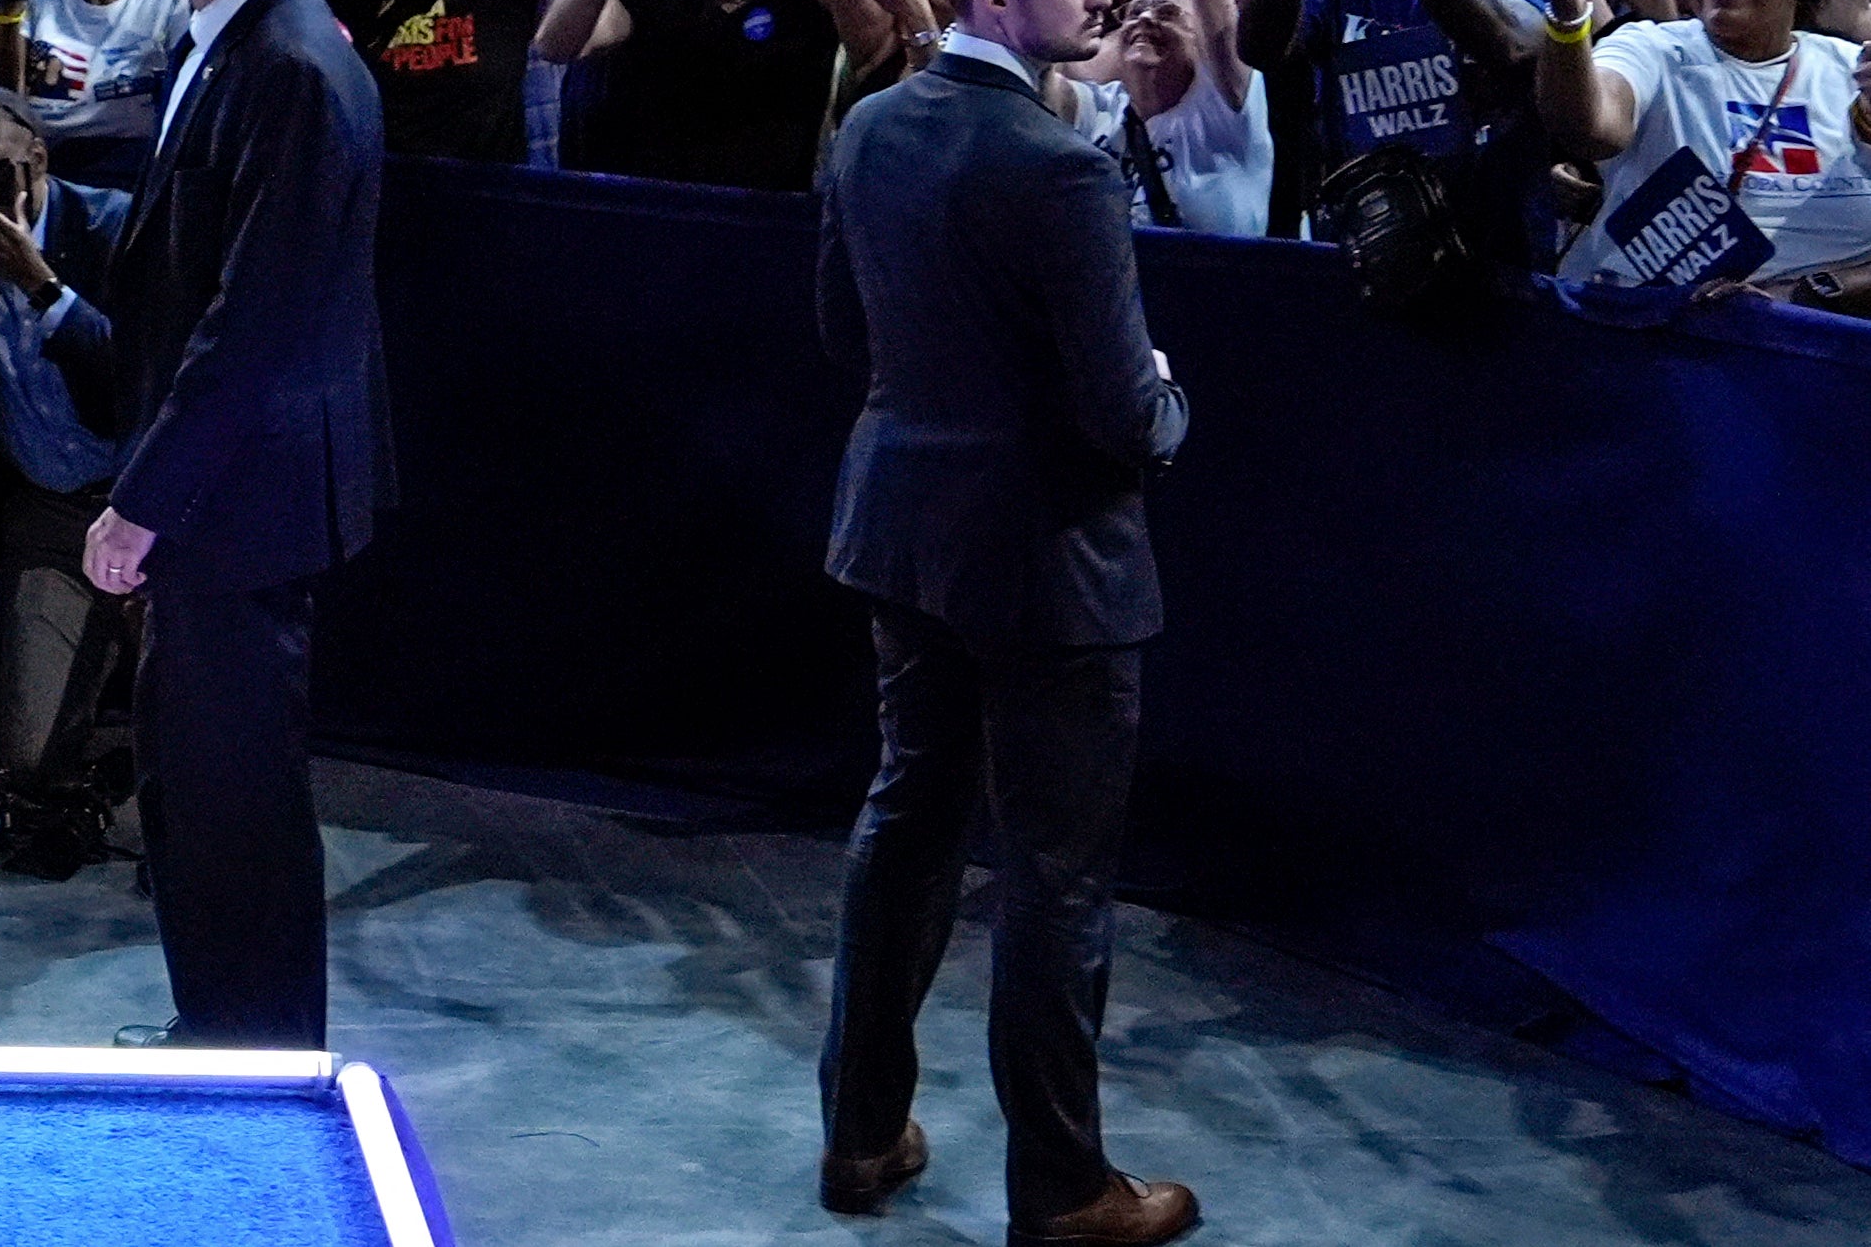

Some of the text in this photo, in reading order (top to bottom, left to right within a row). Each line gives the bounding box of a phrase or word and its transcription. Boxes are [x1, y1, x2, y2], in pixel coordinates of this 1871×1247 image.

[1338, 54, 1458, 115] HARRIS
[1367, 103, 1450, 138] WALZ
[1622, 174, 1732, 280] HARRIS
[1667, 223, 1739, 286] WALZ
